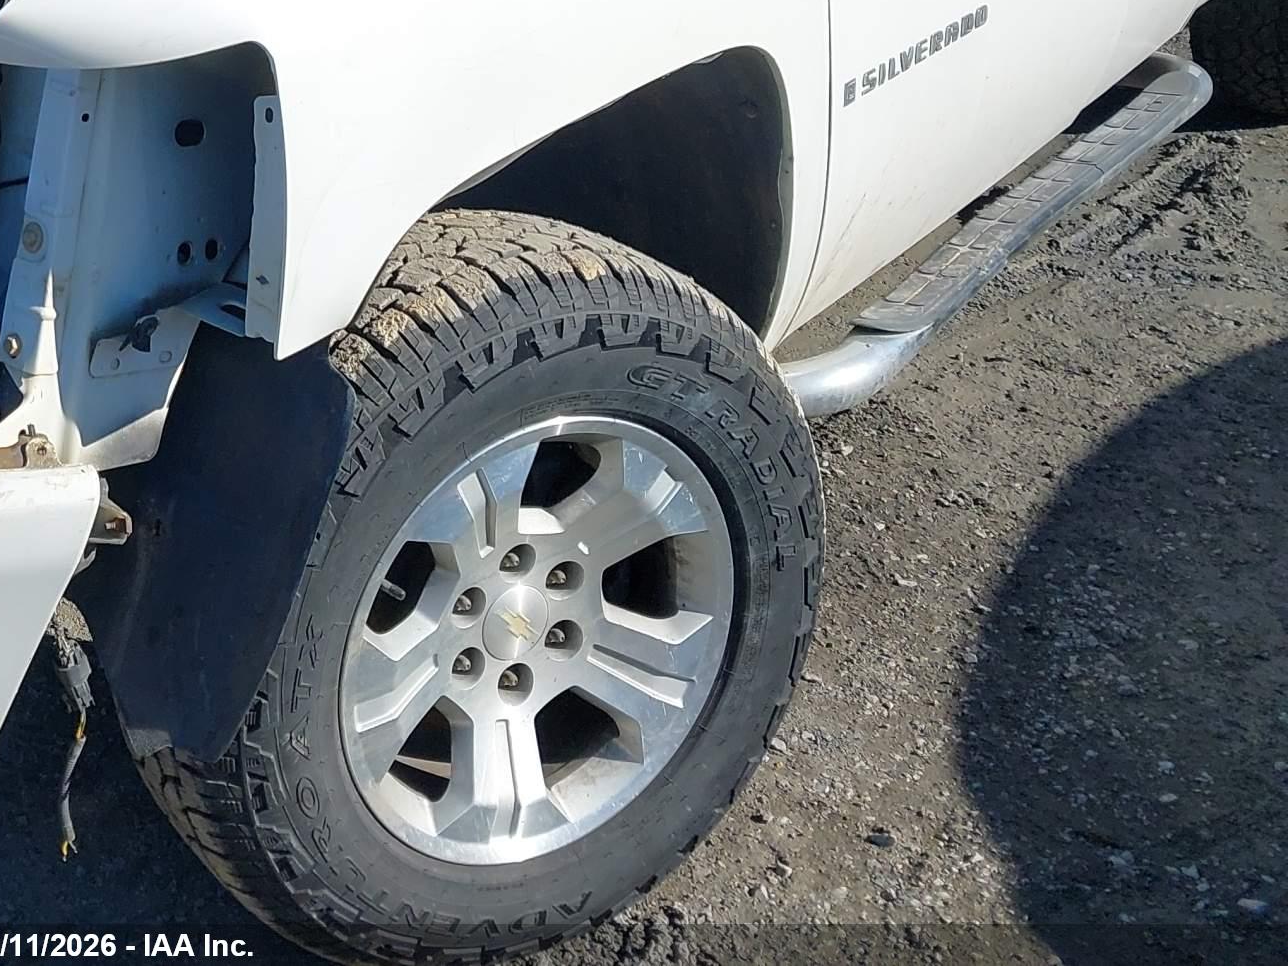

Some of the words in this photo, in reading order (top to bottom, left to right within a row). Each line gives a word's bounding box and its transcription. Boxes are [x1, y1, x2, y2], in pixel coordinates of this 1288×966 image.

[861, 4, 988, 96] SILVERADO
[626, 364, 710, 401] GT
[705, 399, 798, 572] RADIAL
